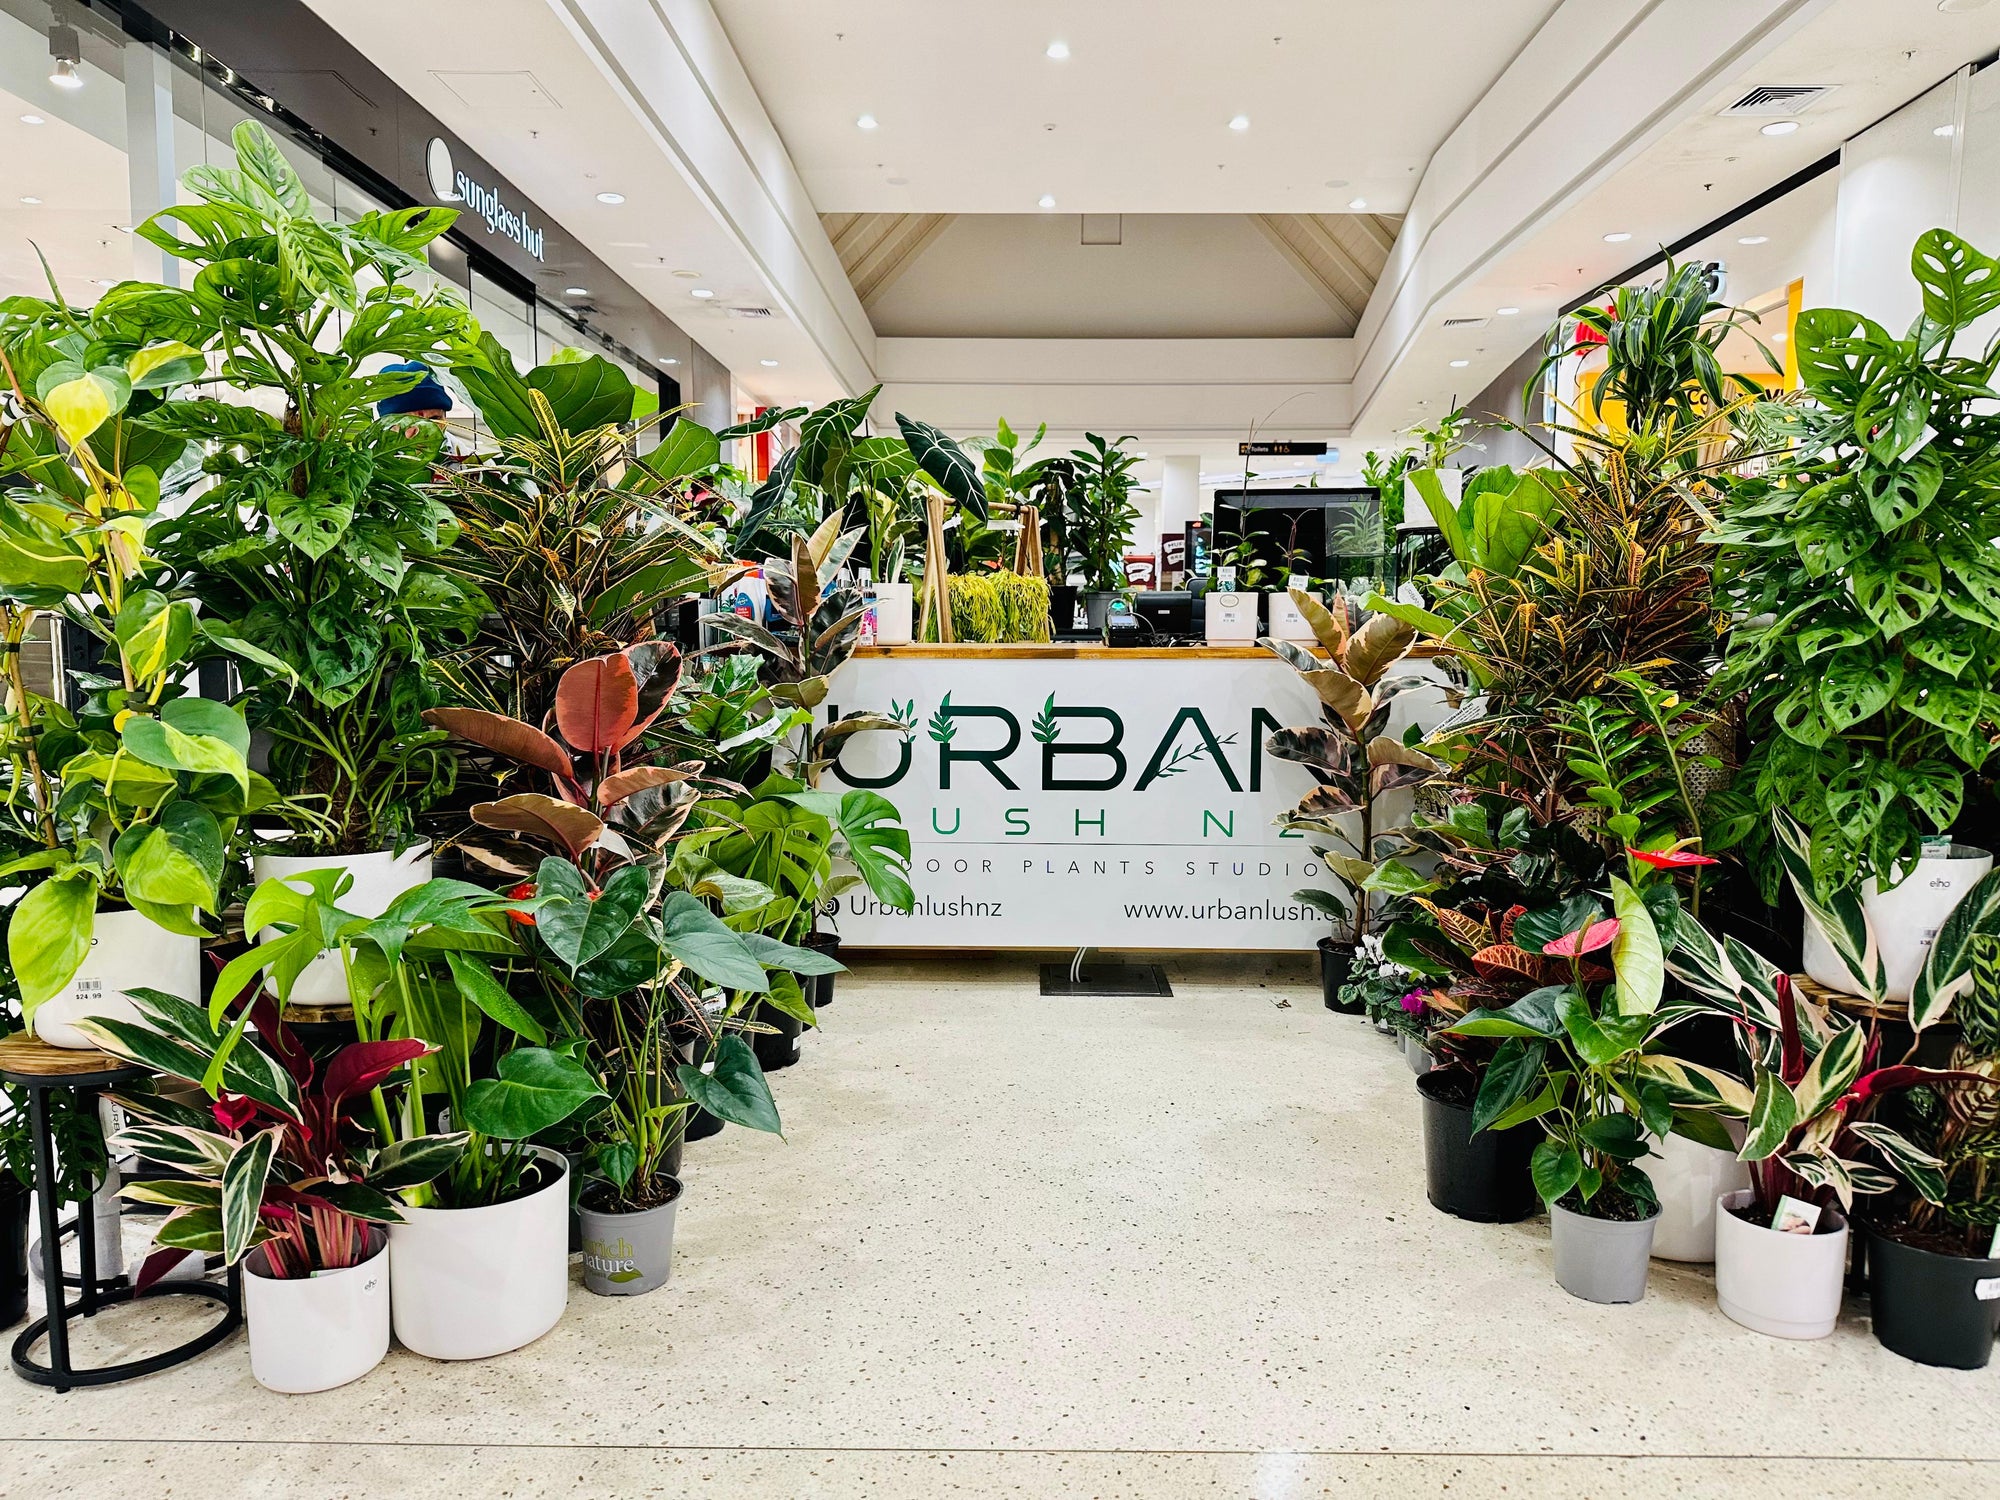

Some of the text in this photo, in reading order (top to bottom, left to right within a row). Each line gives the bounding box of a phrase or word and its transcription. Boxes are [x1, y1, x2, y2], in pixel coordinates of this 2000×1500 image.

[456, 170, 545, 262] sunglass hut
[871, 806, 1106, 837] USH
[857, 857, 1319, 877] DOOR PLANTS STUDIO
[1929, 877, 1951, 889] elho
[75, 992, 102, 1000] $24.99
